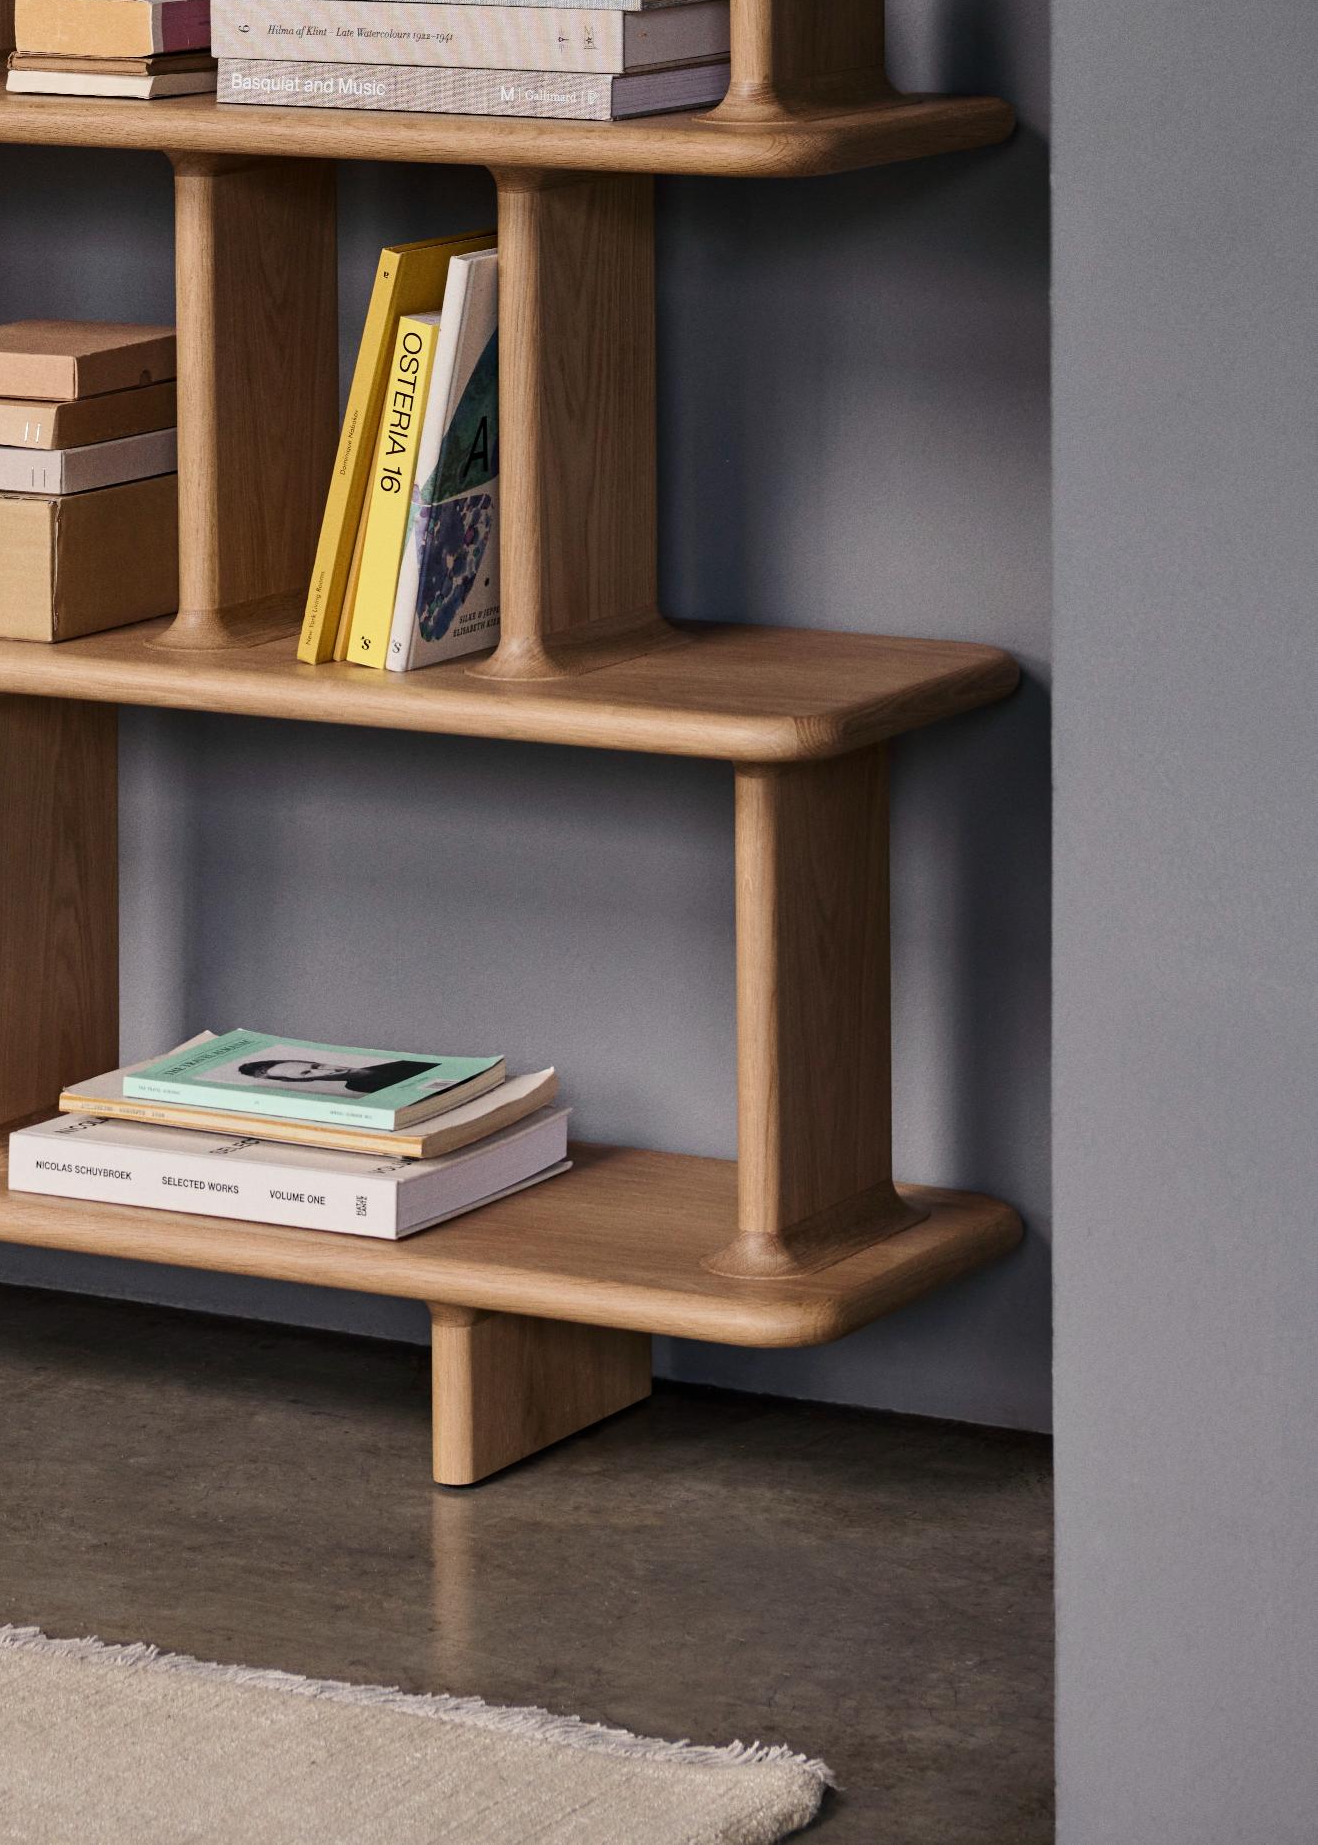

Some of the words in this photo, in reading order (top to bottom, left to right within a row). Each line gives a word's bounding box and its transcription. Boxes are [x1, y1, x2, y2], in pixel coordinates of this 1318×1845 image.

[238, 24, 250, 33] 6
[267, 25, 294, 36] Hilma
[295, 25, 307, 38] af
[306, 25, 327, 36] Klint
[336, 27, 354, 38] Late
[357, 27, 410, 39] Watercolours
[231, 72, 300, 94] Basquiat
[303, 77, 333, 93] and
[338, 78, 386, 96] Music
[500, 86, 515, 101] M
[525, 89, 577, 102] Gallimard
[386, 332, 423, 456] OSTERIA
[339, 440, 352, 476] Dominique
[347, 410, 359, 438] Nabokov
[462, 416, 488, 478] A
[380, 466, 403, 494] 16
[316, 571, 325, 592] Rooms
[312, 594, 322, 613] Living
[35, 1160, 73, 1173] NICOLAS
[74, 1165, 132, 1181] SCHUYBROEK
[161, 1176, 205, 1190] SELECTED
[207, 1181, 239, 1194] WORKS
[269, 1190, 305, 1203] VOLUME
[307, 1195, 326, 1205] ONE
